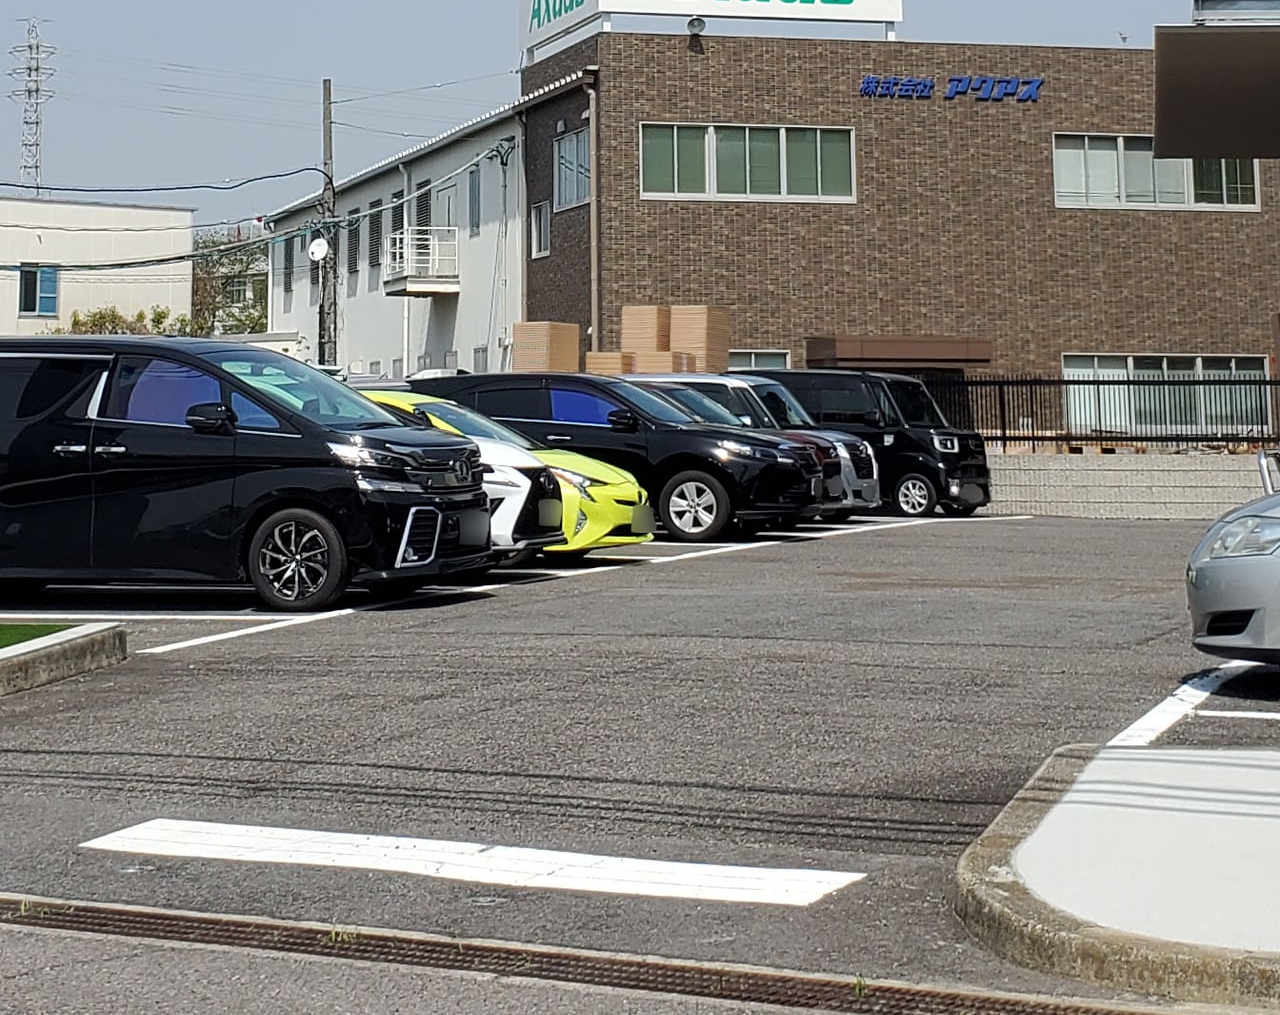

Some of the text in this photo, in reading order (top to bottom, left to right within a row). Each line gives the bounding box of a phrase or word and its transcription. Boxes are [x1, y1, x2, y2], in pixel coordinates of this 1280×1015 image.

[860, 75, 1044, 102] 株式会社 アクアス
